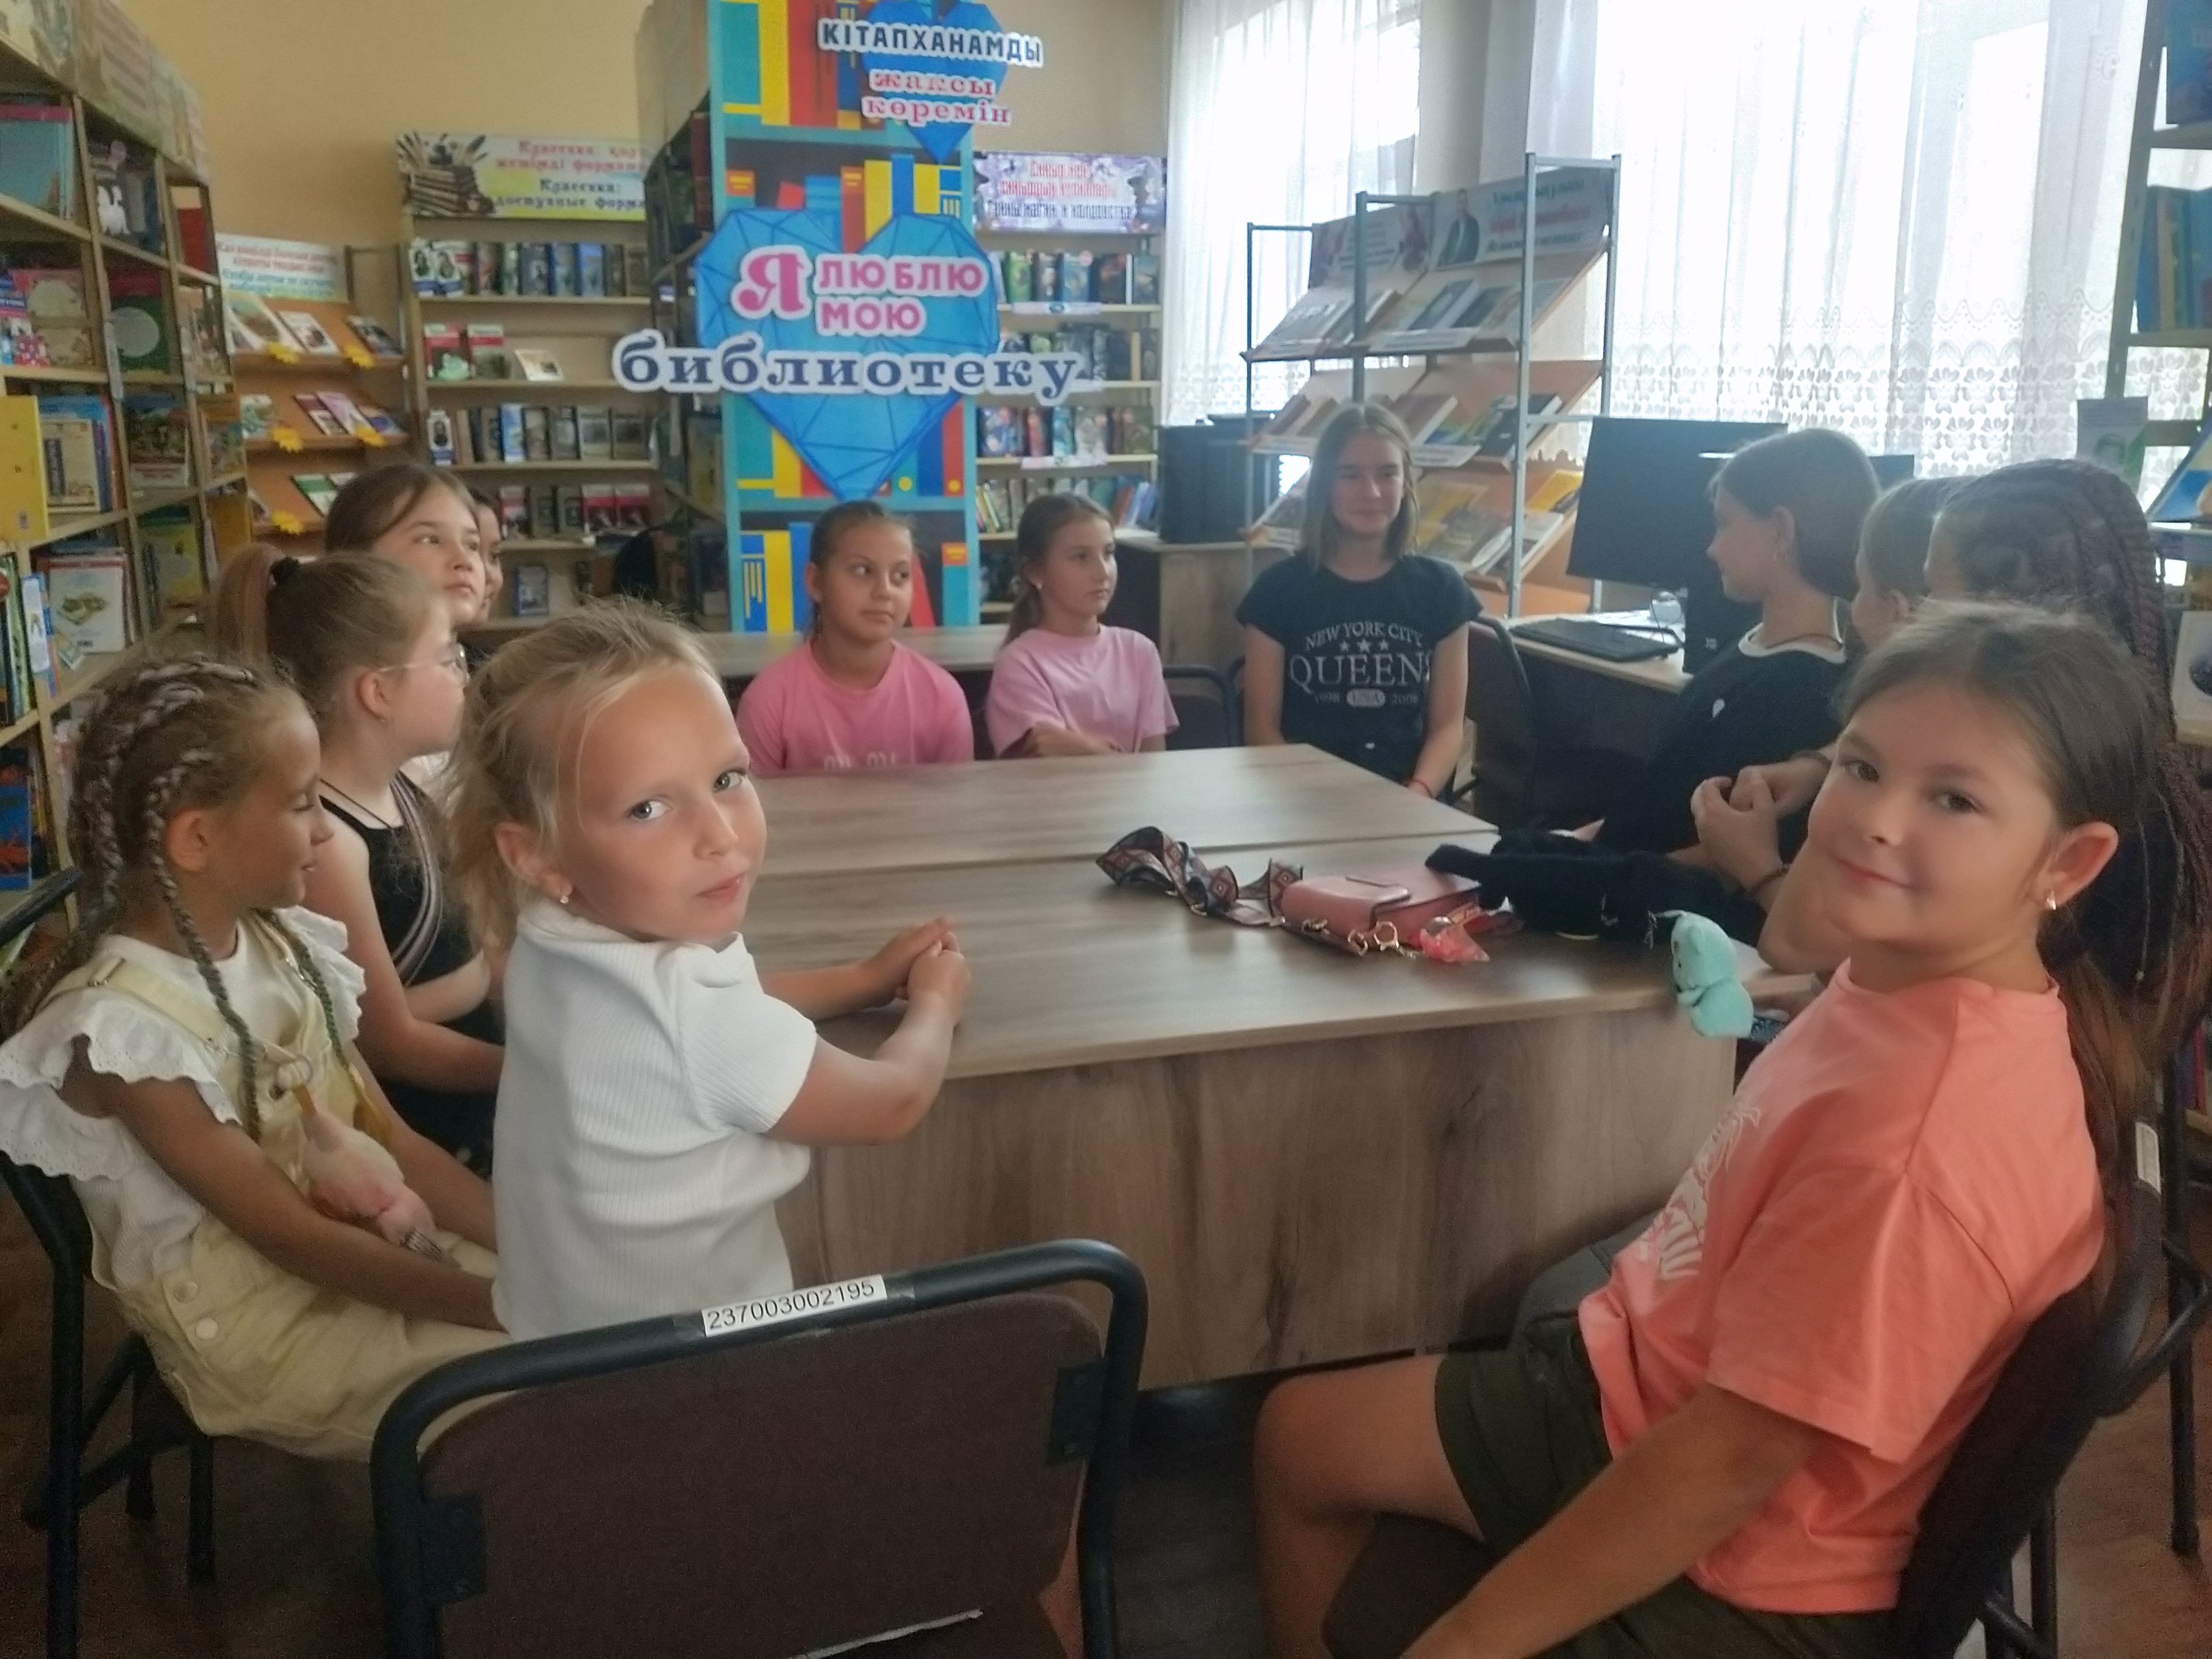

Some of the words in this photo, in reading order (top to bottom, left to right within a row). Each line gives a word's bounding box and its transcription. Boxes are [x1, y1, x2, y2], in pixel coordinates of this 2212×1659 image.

[822, 23, 1041, 62] КІТАПХАНАМДЫ
[867, 99, 1010, 123] көремін
[738, 252, 804, 313] Я
[819, 260, 983, 291] ЛЮБЛЮ
[821, 302, 921, 331] МОЮ
[619, 336, 1076, 399] библиотеку
[1305, 625, 1339, 651] NEW
[1343, 621, 1384, 637] YORK
[1387, 625, 1422, 648] CITY
[707, 1281, 875, 1331] 237003002195
